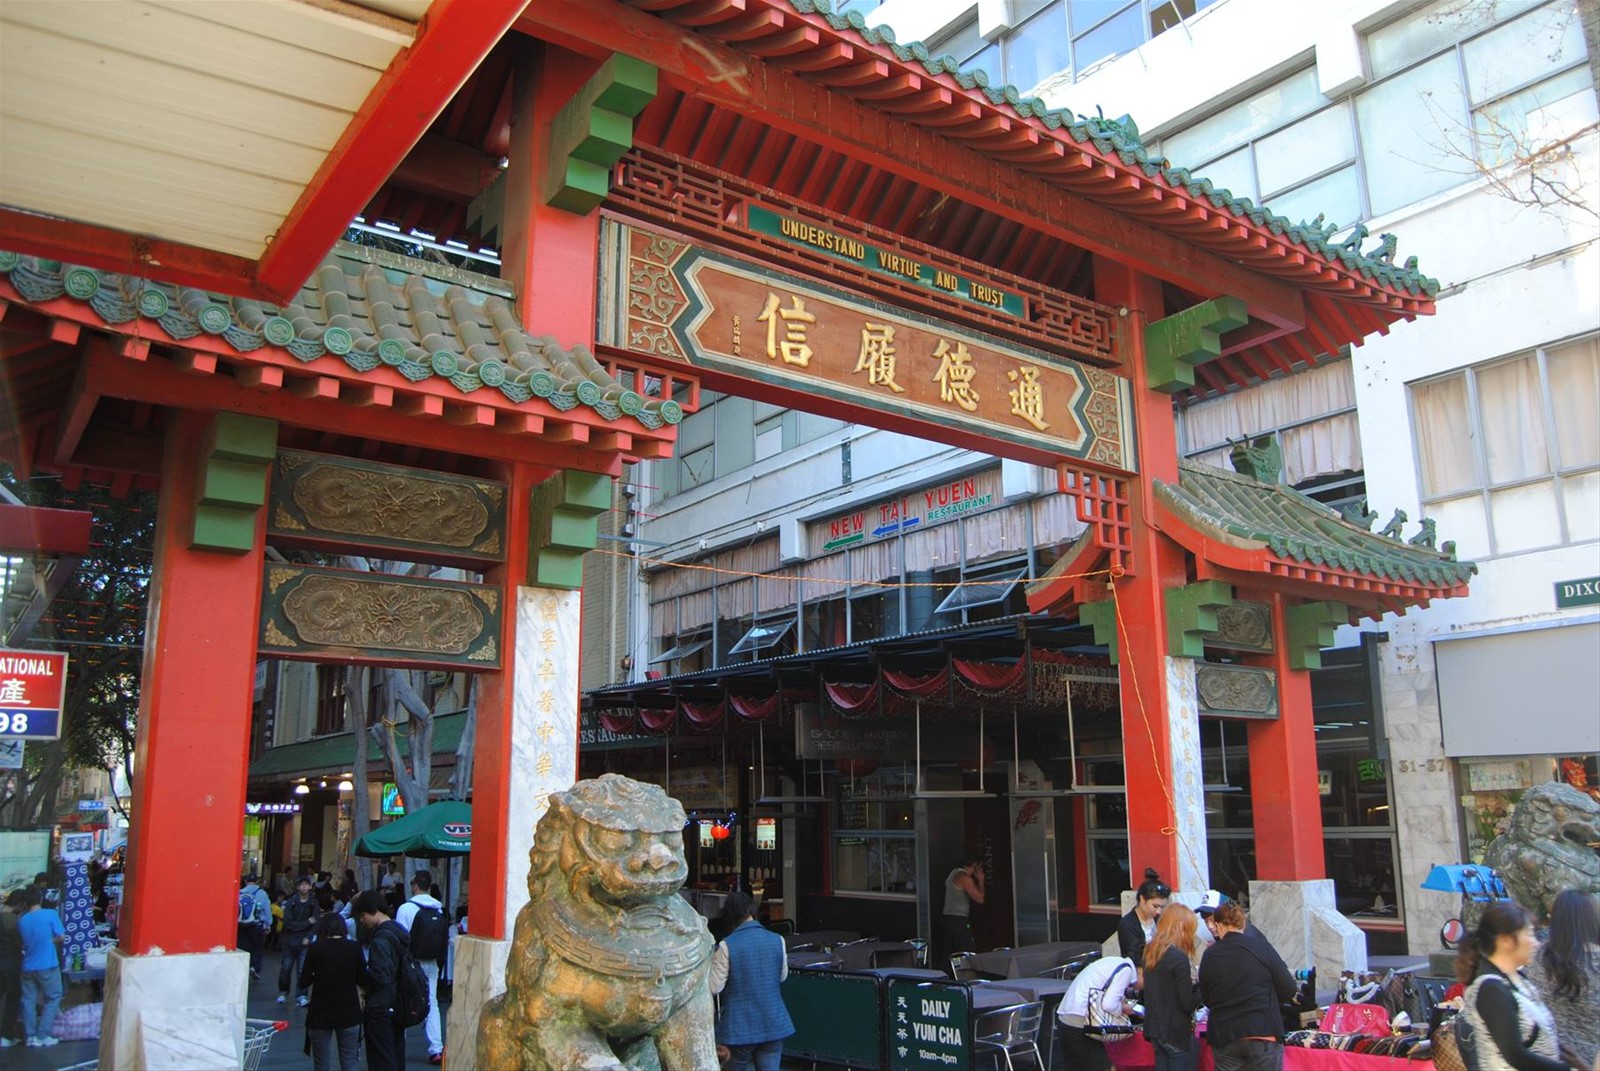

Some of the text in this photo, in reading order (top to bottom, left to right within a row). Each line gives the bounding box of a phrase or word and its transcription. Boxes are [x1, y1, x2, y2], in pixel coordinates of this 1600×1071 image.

[780, 216, 1005, 306] UNDERSTAND VIRTUE AND TRUST
[830, 478, 976, 538] NEW TAI YUEN
[927, 494, 993, 521] RESTAURANT
[0, 657, 54, 676] ATIONAL
[0, 677, 32, 705] 產
[0, 712, 29, 734] 98
[1399, 757, 1446, 774] 31-37
[922, 998, 950, 1018] DAILY
[897, 996, 909, 1058] 天天茶市
[912, 1022, 962, 1046] YUM CHA
